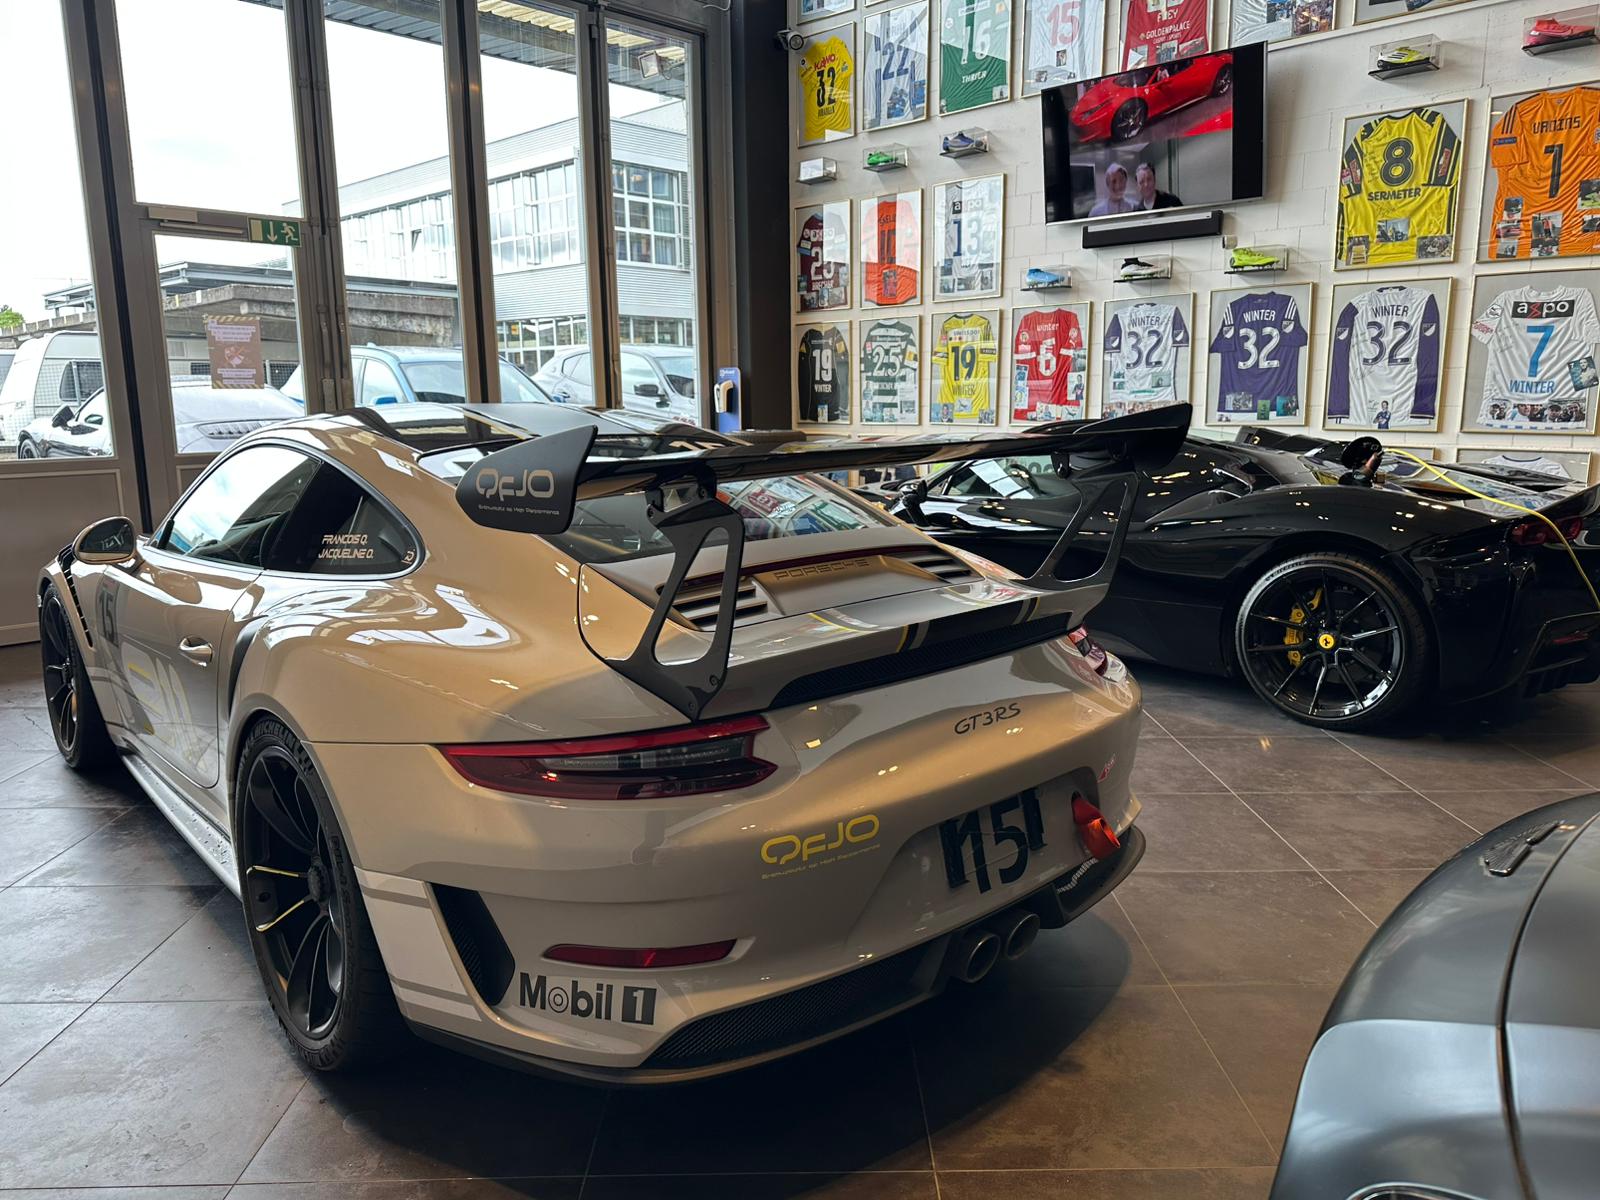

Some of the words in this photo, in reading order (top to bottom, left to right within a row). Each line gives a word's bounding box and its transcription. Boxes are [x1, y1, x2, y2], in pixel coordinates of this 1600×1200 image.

[960, 20, 992, 65] 16
[1046, 4, 1080, 46] 15
[881, 41, 909, 81] 22
[816, 66, 836, 108] 32
[1380, 137, 1414, 187] 8
[1543, 143, 1565, 198] 7
[1367, 187, 1421, 201] SERMETER
[953, 216, 980, 257] 13
[1036, 323, 1060, 333] winter
[1131, 316, 1160, 328] WINTER
[1243, 310, 1276, 324] WINTER
[1372, 304, 1409, 318] WINTER
[872, 345, 901, 378] 25
[1038, 338, 1057, 377] 6
[1125, 329, 1163, 369] 32
[1237, 326, 1280, 370] 32
[1363, 321, 1413, 366] 32
[1527, 325, 1555, 378] 7
[812, 349, 833, 383] 19
[951, 346, 976, 382] 19
[1509, 379, 1555, 394] WINTER
[318, 549, 367, 559] JACQUELINE
[774, 559, 870, 580] PORSCHE
[519, 972, 614, 1021] Mobil
